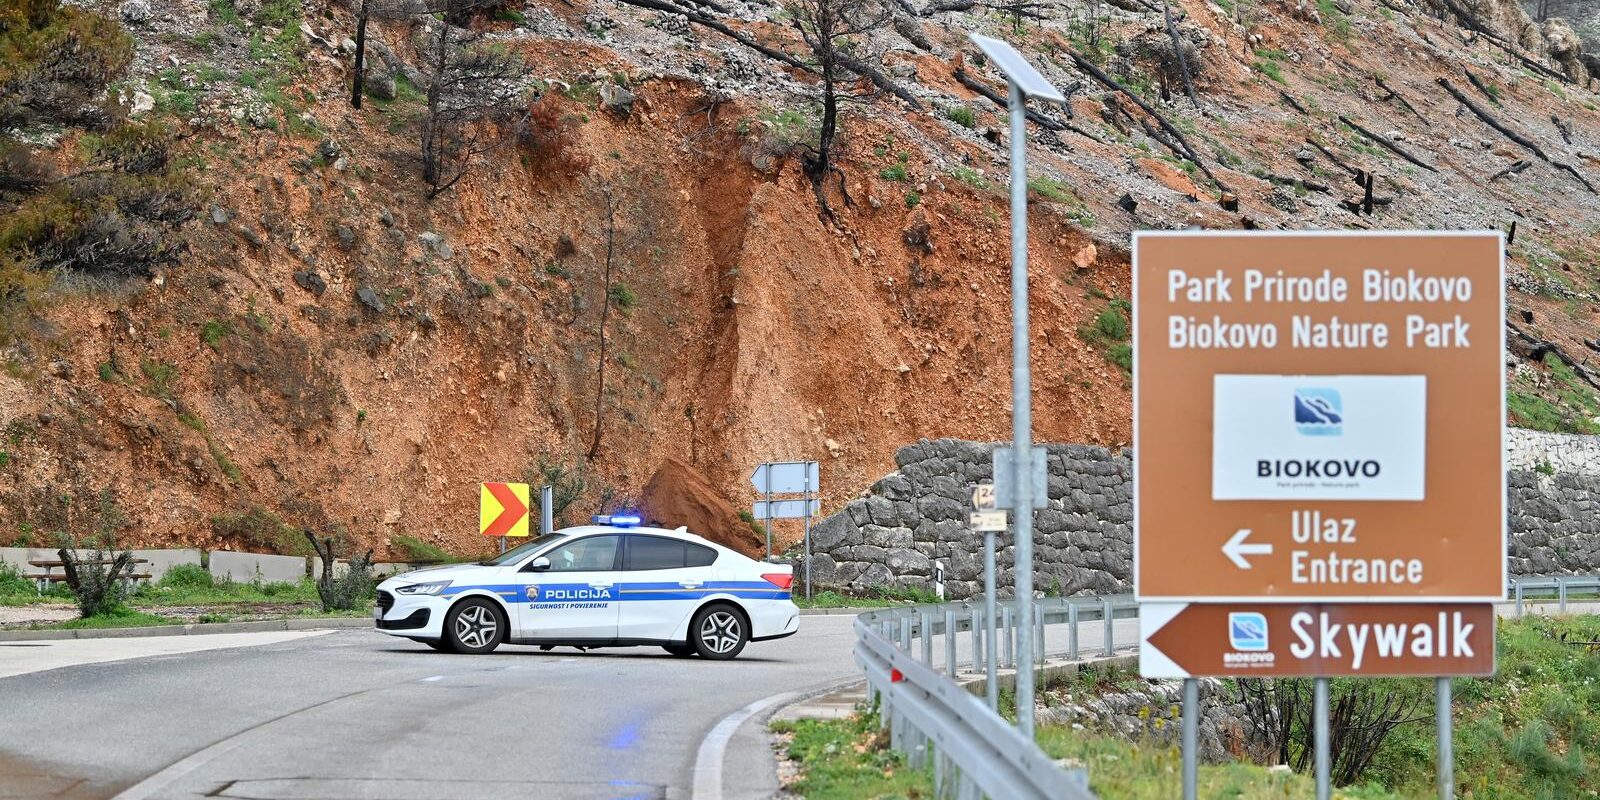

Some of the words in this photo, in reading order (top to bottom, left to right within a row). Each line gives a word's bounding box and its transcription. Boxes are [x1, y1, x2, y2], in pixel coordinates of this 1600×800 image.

[1168, 269, 1232, 302] Park
[1245, 269, 1348, 302] Prirode
[1363, 269, 1472, 302] Biokovo
[1168, 315, 1277, 348] Biokovo
[1292, 315, 1389, 348] Nature
[1406, 315, 1470, 348] Park
[1257, 460, 1381, 478] BIOKOVO
[1292, 511, 1356, 543] Ulaz
[1291, 551, 1423, 584] Entrance
[545, 589, 611, 599] POLICIJA
[1290, 612, 1475, 669] Skywalk
[1223, 652, 1275, 662] BIOKOVO
